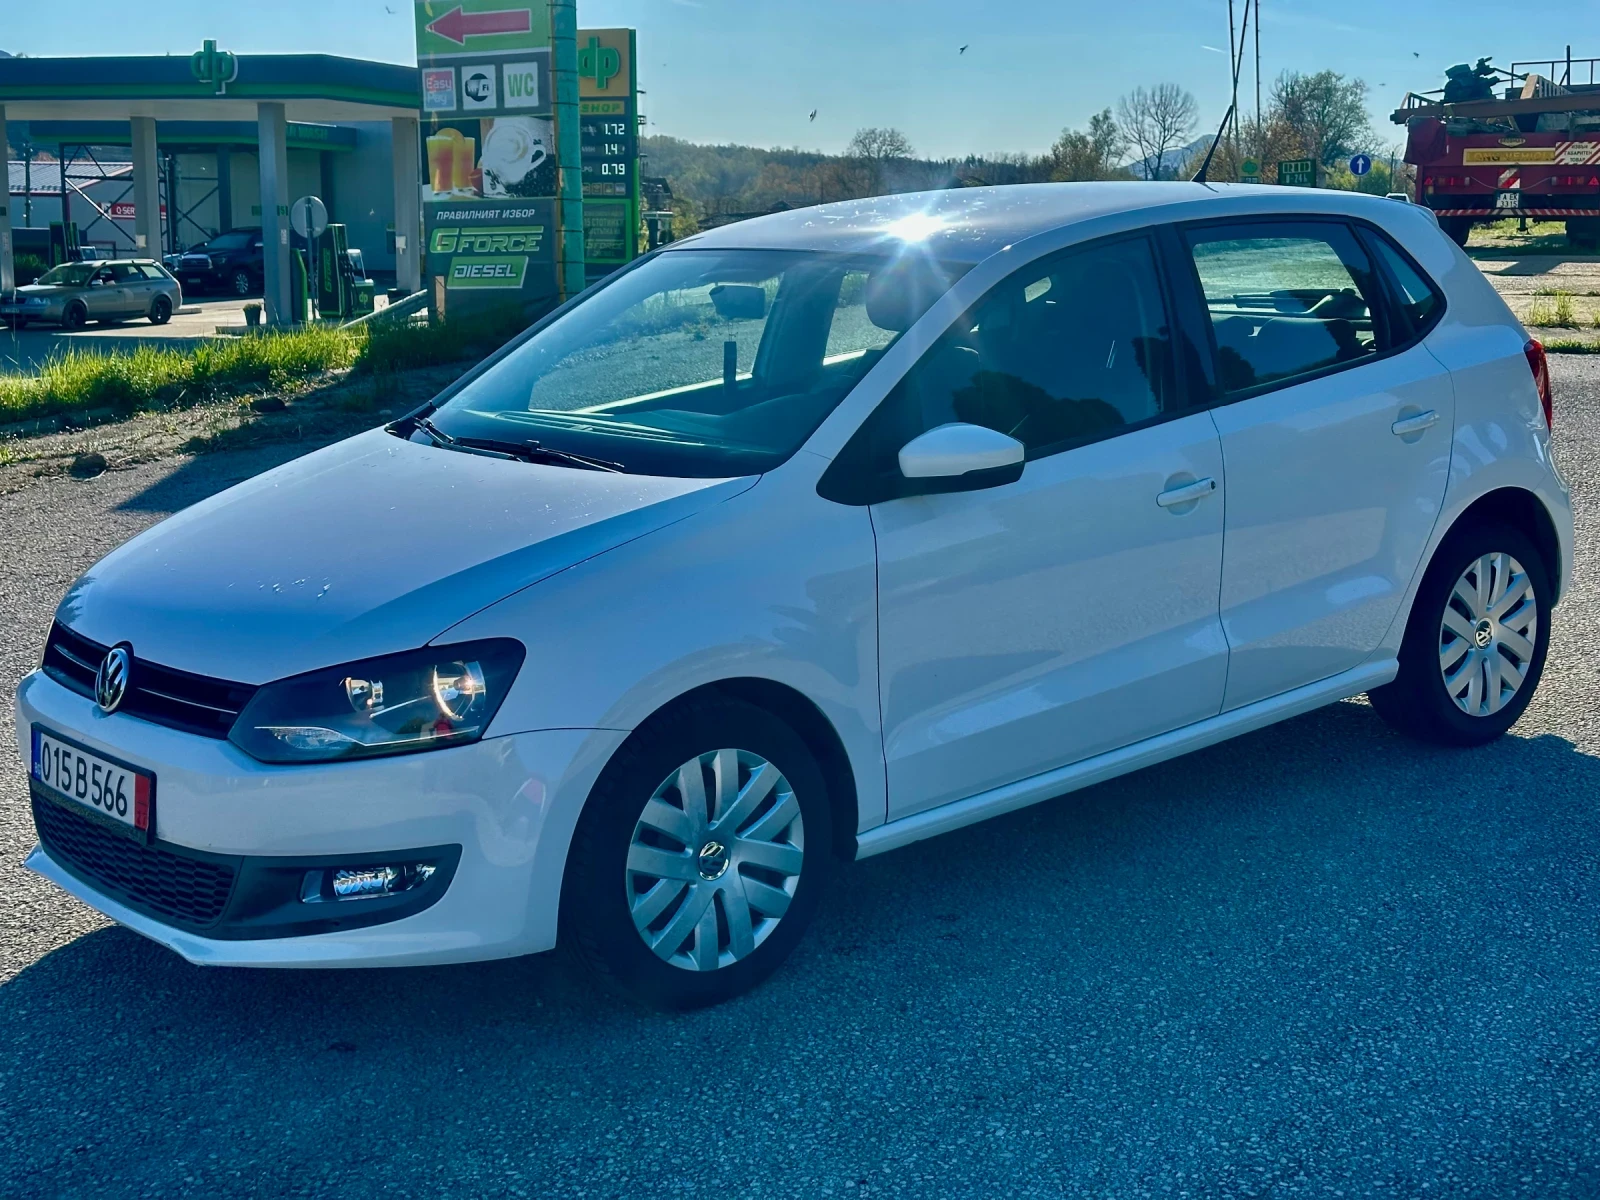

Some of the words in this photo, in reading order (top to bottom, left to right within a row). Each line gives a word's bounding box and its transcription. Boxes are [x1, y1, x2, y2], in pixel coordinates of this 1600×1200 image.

[426, 77, 452, 91] Easy
[508, 72, 534, 97] WC
[581, 103, 621, 113] SHOP
[604, 123, 625, 135] 1.72
[601, 163, 625, 175] 0.79
[436, 209, 501, 220] ПРАВИЛНИЯТ
[502, 209, 535, 219] ИЗБОР
[453, 264, 517, 278] DIESEL
